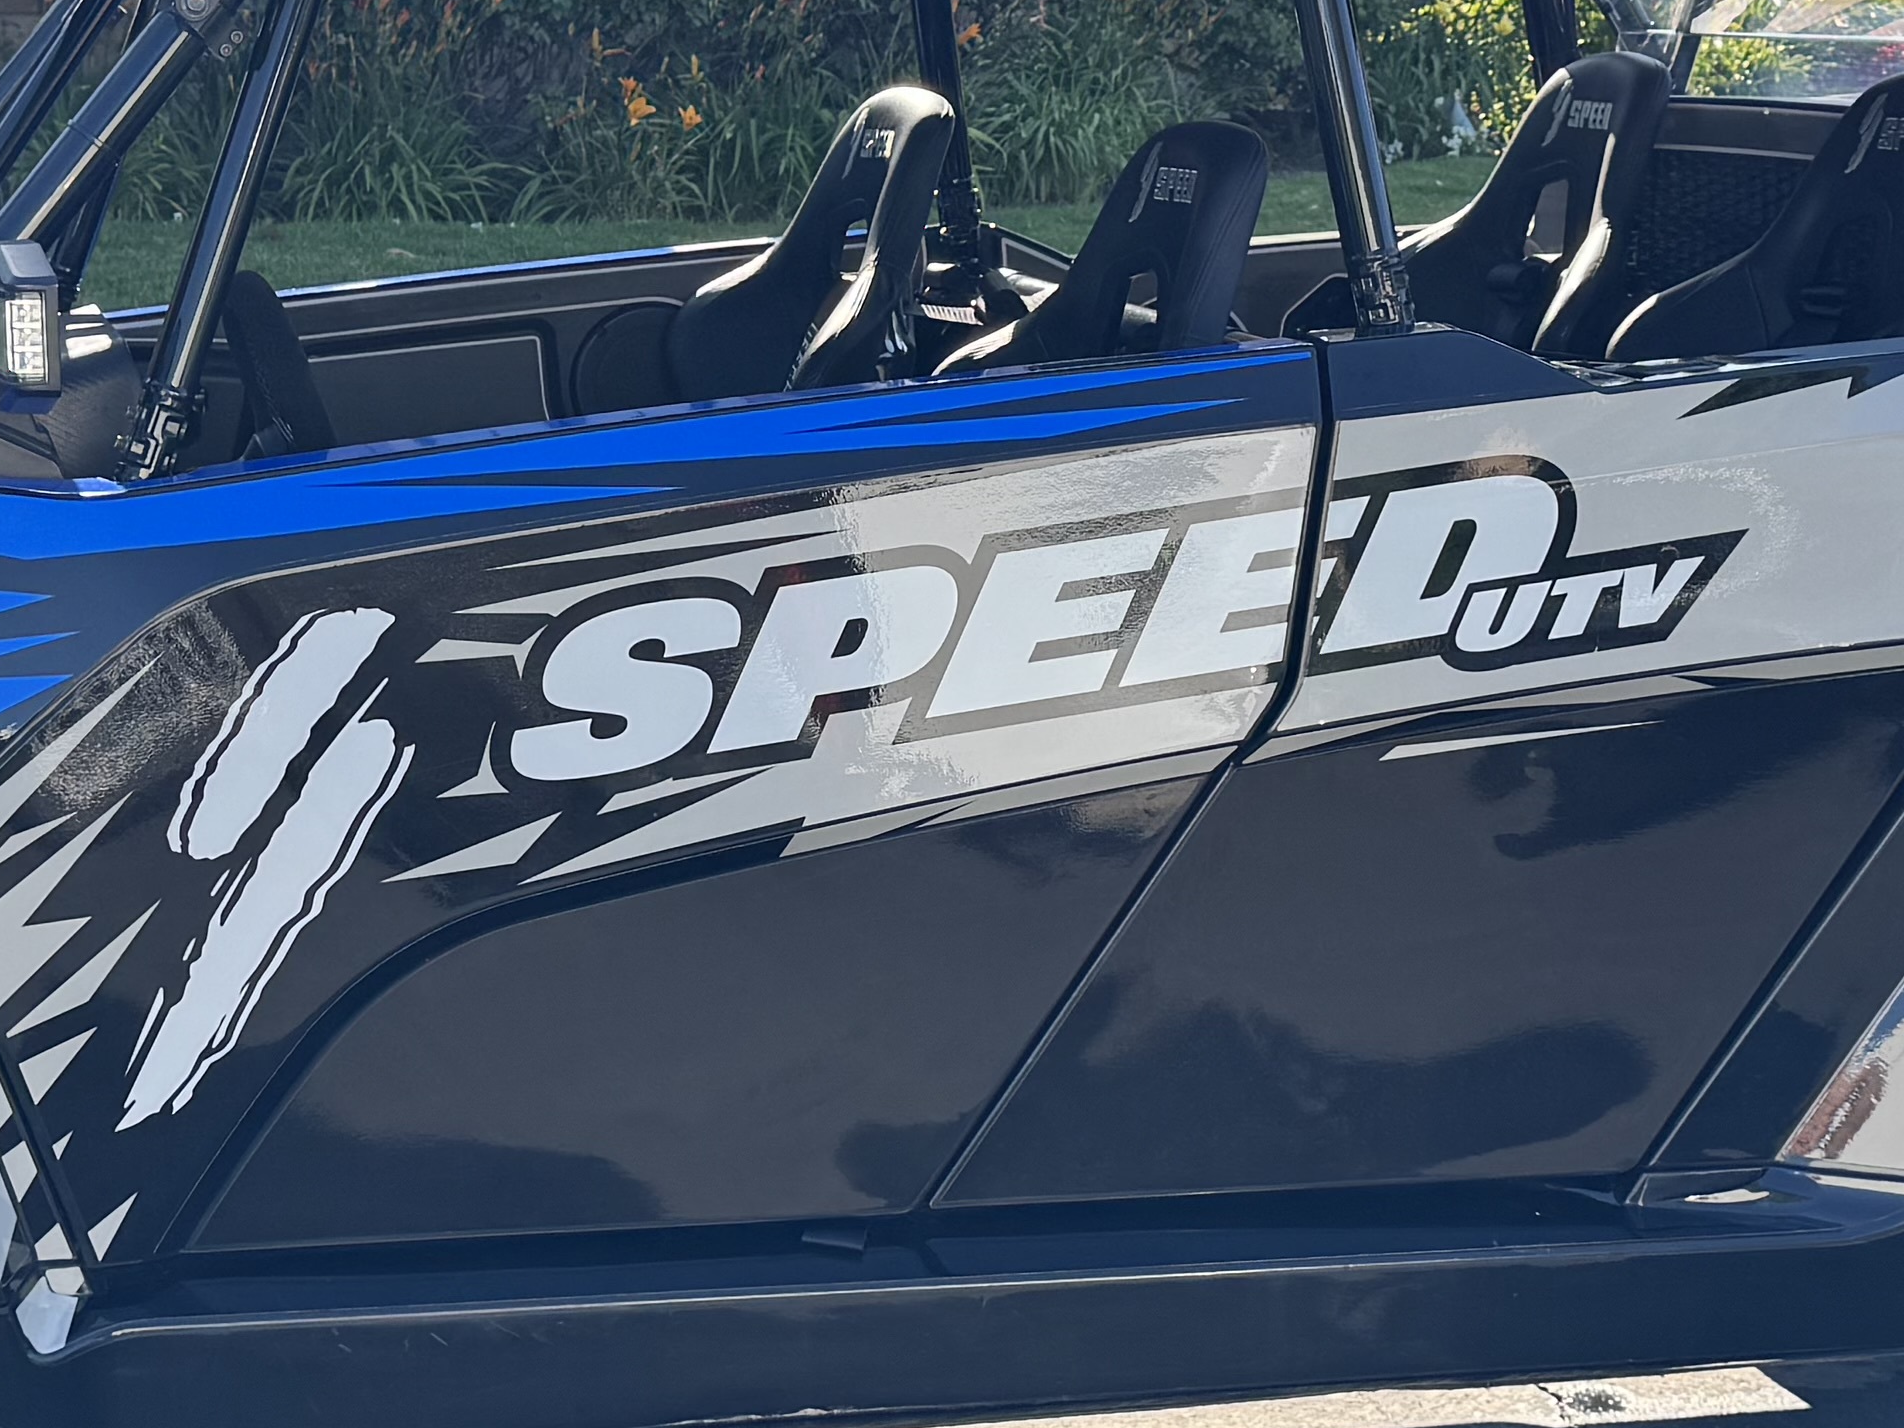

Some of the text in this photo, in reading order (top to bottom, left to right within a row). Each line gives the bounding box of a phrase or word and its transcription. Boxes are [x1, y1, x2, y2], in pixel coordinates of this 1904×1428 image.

[1567, 99, 1613, 131] SPEED
[1153, 166, 1198, 204] SPEED
[508, 470, 1706, 784] SPEED UTV
